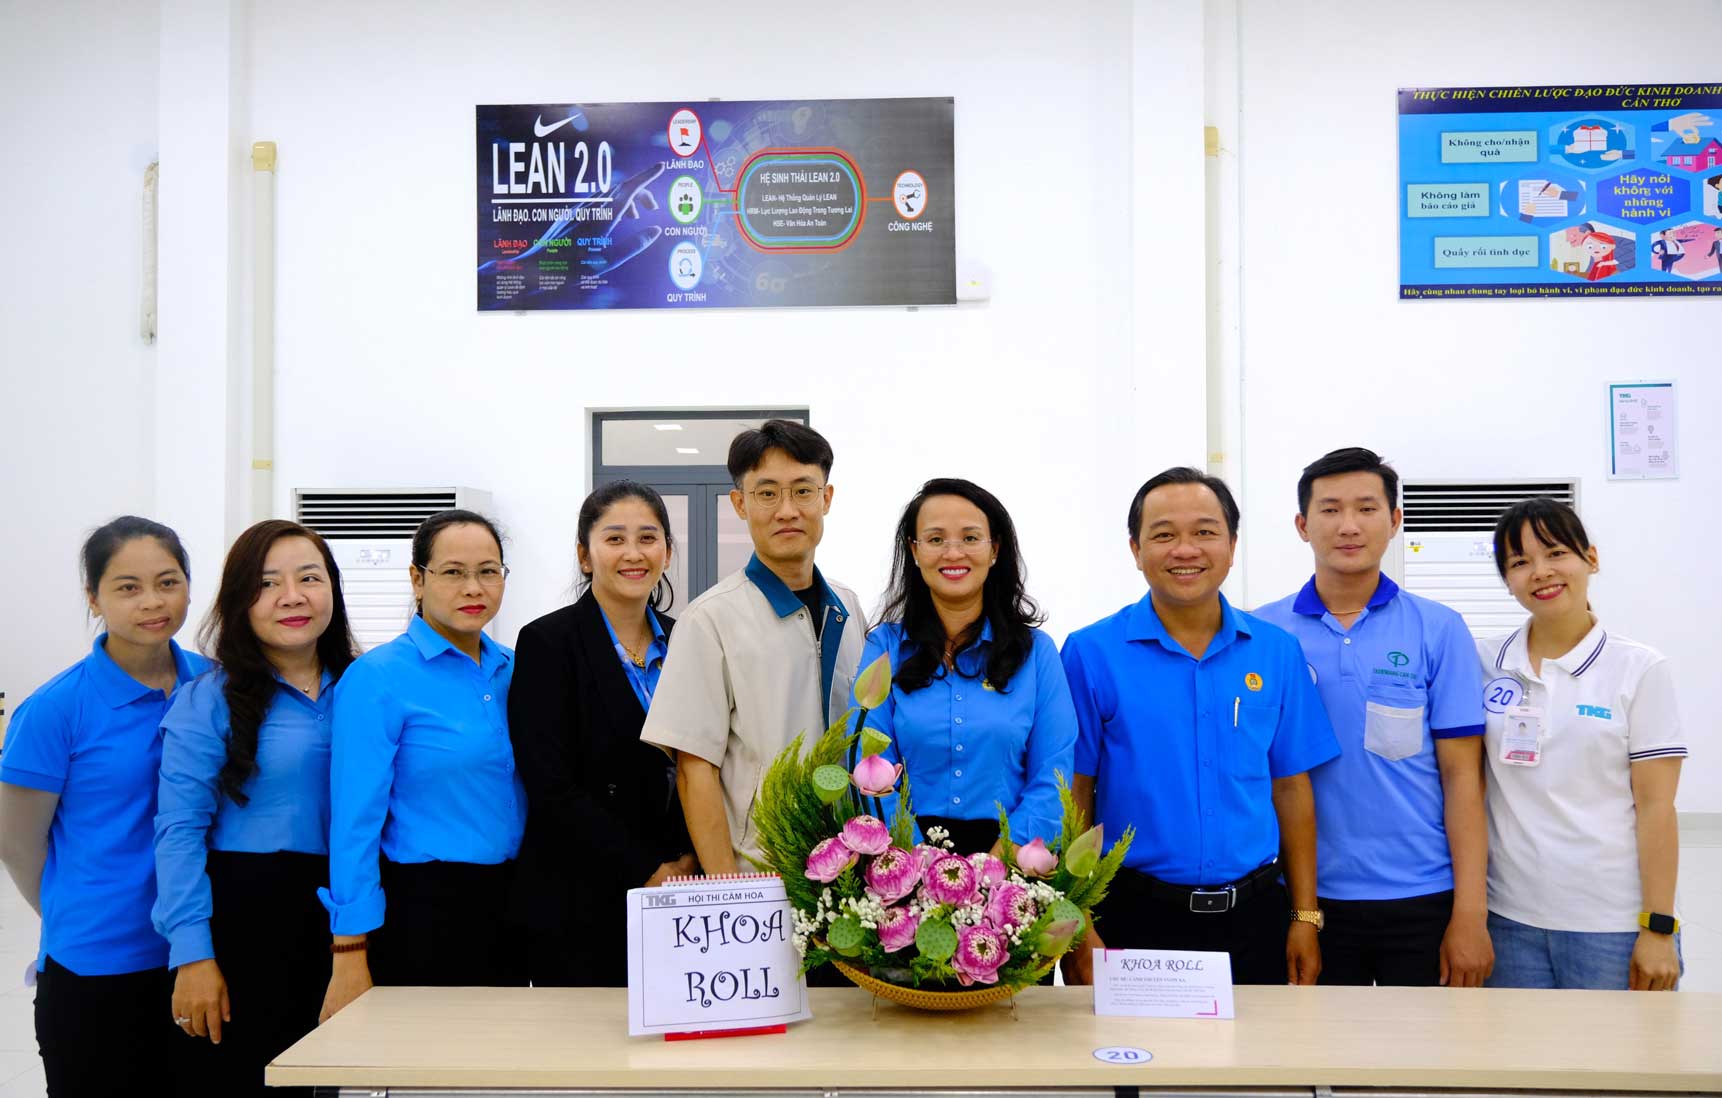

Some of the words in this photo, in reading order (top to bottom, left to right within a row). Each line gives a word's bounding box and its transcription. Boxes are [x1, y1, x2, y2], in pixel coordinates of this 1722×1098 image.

[1414, 89, 1450, 102] THỰC
[1452, 88, 1485, 100] HIỆN
[1534, 87, 1572, 100] LƯỢC
[1574, 87, 1602, 98] ĐẠO
[1606, 86, 1635, 96] ĐỨC
[1637, 86, 1671, 96] KINH
[1674, 86, 1722, 95] DOANH
[1653, 97, 1682, 107] THƠ
[1448, 138, 1482, 148] Không
[492, 142, 565, 194] LEAN
[574, 141, 612, 194] 2.0
[666, 158, 686, 170] LÃNH
[688, 160, 704, 170] ĐẠO
[760, 172, 770, 187] HỆ
[772, 172, 789, 184] SINH
[808, 172, 828, 183] LEAN
[830, 172, 840, 182] 2.0
[1620, 174, 1646, 186] Hãy
[1650, 173, 1670, 184] nói
[823, 192, 837, 201] LEAN
[1421, 191, 1458, 200] Không
[1460, 191, 1480, 199] làm
[1614, 186, 1651, 196] không
[1654, 185, 1673, 194] với
[1624, 198, 1664, 208] những
[493, 206, 512, 222] LÃNH
[532, 208, 547, 222] CON
[576, 208, 590, 222] QUY
[592, 204, 612, 220] TRÌNH
[812, 206, 826, 215] Trong
[1622, 208, 1655, 218] hành
[1659, 208, 1670, 217] vi
[664, 227, 681, 236] CON
[888, 220, 910, 232] CÔNG
[912, 221, 934, 232] NGHỆ
[576, 238, 591, 246] QUY
[666, 293, 682, 303] QUY
[684, 291, 706, 302] TRÌNH
[1422, 288, 1442, 296] cùng
[1468, 288, 1492, 296] chung
[1510, 287, 1524, 295] loại
[1584, 286, 1608, 294] phạm
[1610, 286, 1625, 294] đạo
[1488, 686, 1514, 706] 20
[1576, 704, 1612, 720] TKG
[644, 894, 677, 906] TKG
[688, 894, 704, 904] HỘI
[707, 894, 720, 902] THI
[744, 891, 764, 900] HOA
[672, 909, 786, 954] KHOA
[1120, 958, 1162, 971] KHOA
[1165, 960, 1204, 972] ROLL
[684, 966, 780, 1008] ROLL
[1106, 1051, 1139, 1060] 20
